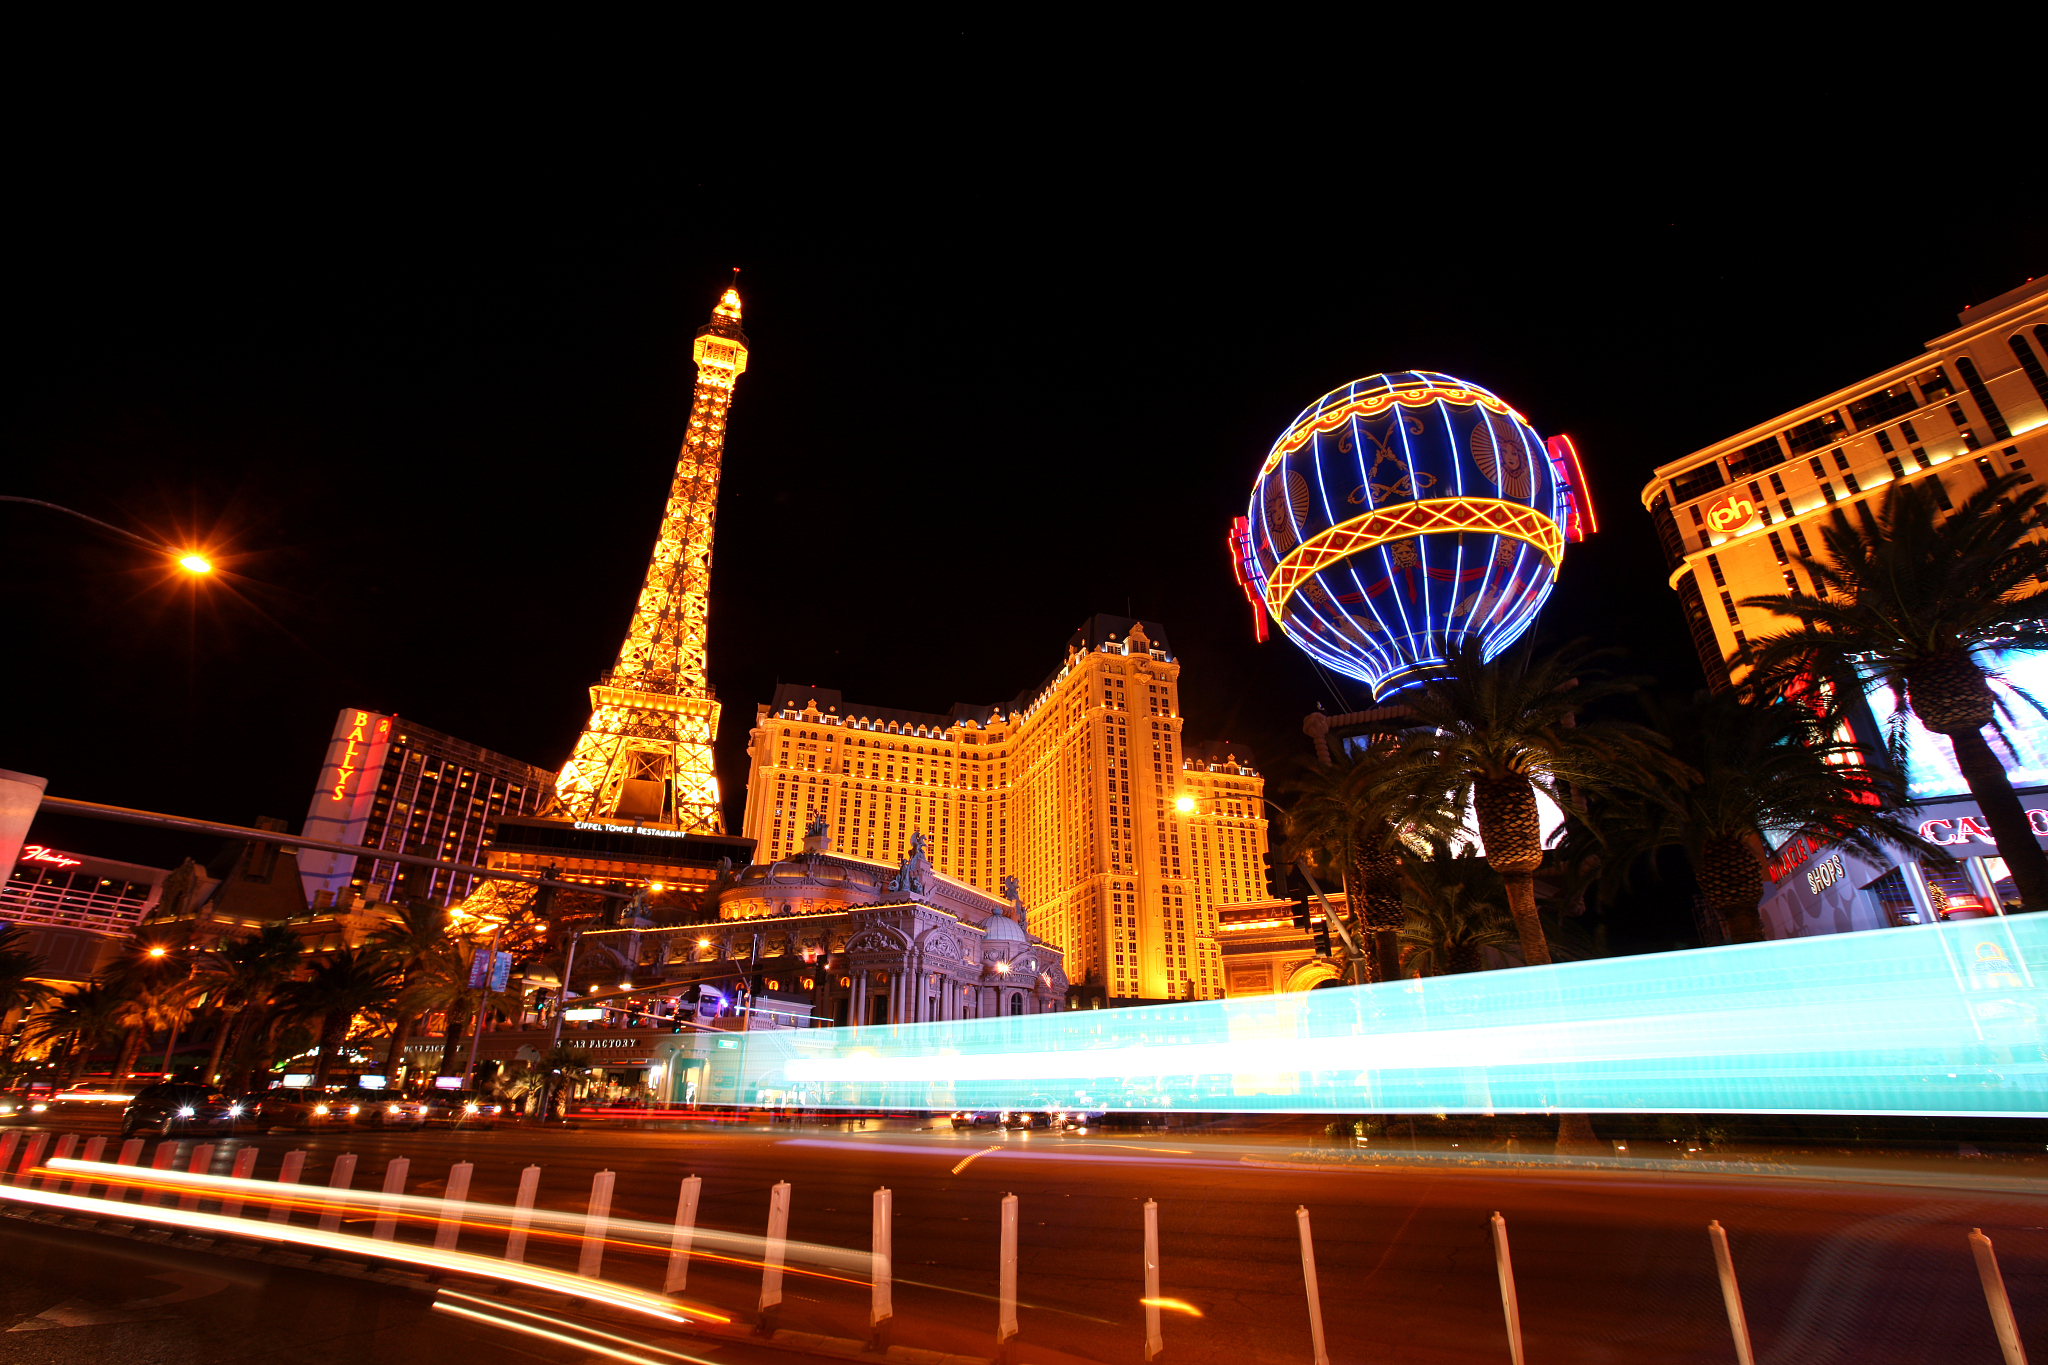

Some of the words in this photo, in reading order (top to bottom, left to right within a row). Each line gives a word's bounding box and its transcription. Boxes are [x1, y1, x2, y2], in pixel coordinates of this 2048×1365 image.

[1711, 496, 1753, 530] ph
[332, 711, 369, 801] BALLYS
[574, 821, 603, 832] EIFFEL
[605, 823, 634, 834] TOWER
[637, 826, 687, 838] RESTAURANT
[1768, 838, 1808, 884] MIRACLE
[1807, 854, 1845, 895] SHOPS
[588, 1038, 637, 1049] FACTORY
